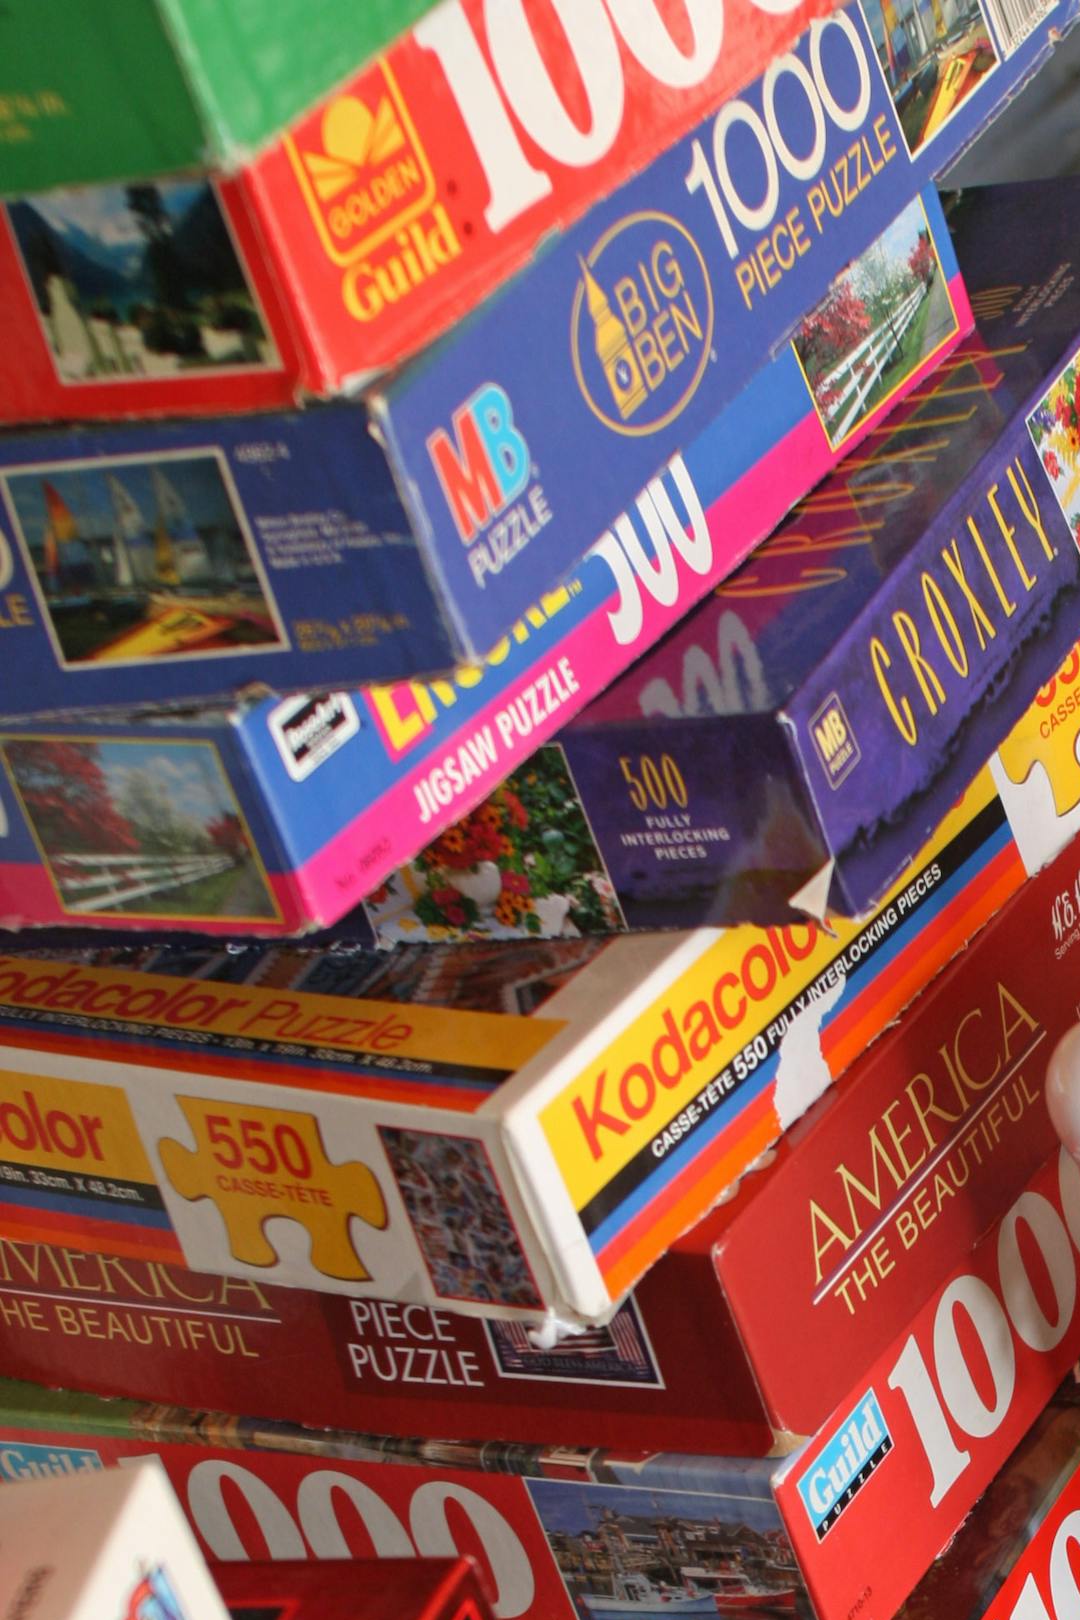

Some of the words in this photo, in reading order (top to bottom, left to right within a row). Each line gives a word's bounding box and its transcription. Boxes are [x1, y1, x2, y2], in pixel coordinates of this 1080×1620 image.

[685, 13, 871, 260] 1000
[328, 161, 421, 238] GOLDEN
[733, 201, 812, 309] PIECE
[808, 114, 898, 232] PUZZLE
[340, 205, 462, 322] Guild
[615, 241, 684, 339] BIG
[636, 298, 702, 408] BEN
[426, 382, 531, 547] MB
[467, 487, 553, 588] PUZZLE
[870, 456, 1055, 746] CROXLEY
[412, 733, 497, 823] JIGSAW
[494, 657, 581, 748] PUZZLE
[619, 752, 688, 811] 500
[814, 708, 847, 761] MB
[619, 827, 731, 845] INTERLOCKING
[645, 814, 691, 830] FULLY
[655, 846, 707, 860] PIECES
[1055, 930, 1080, 960] Serving
[241, 1000, 413, 1050] Puzzle
[570, 918, 838, 1160] Kodacolo
[650, 1072, 736, 1158] CASSE-TÊTE
[732, 1036, 769, 1080] 550
[765, 998, 813, 1045] FULLY
[805, 912, 898, 1014] INTERLOCKING
[896, 865, 944, 924] PIECES
[32, 1169, 68, 1189] 33cm.
[73, 1177, 87, 1193] X
[204, 1114, 314, 1180] 550
[808, 981, 1041, 1285] AMERICA
[215, 1174, 334, 1207] CASSE-TÊTE
[835, 1243, 897, 1315] THE
[896, 1074, 1041, 1250] BEAUTIFUL
[54, 1301, 259, 1358] BEAUTIFUL
[348, 1344, 485, 1387] PUZZLE
[351, 1302, 457, 1343] PIECE
[807, 1405, 883, 1516] Guild
[820, 1440, 892, 1535] PUZZLE
[118, 1454, 535, 1619] 000
